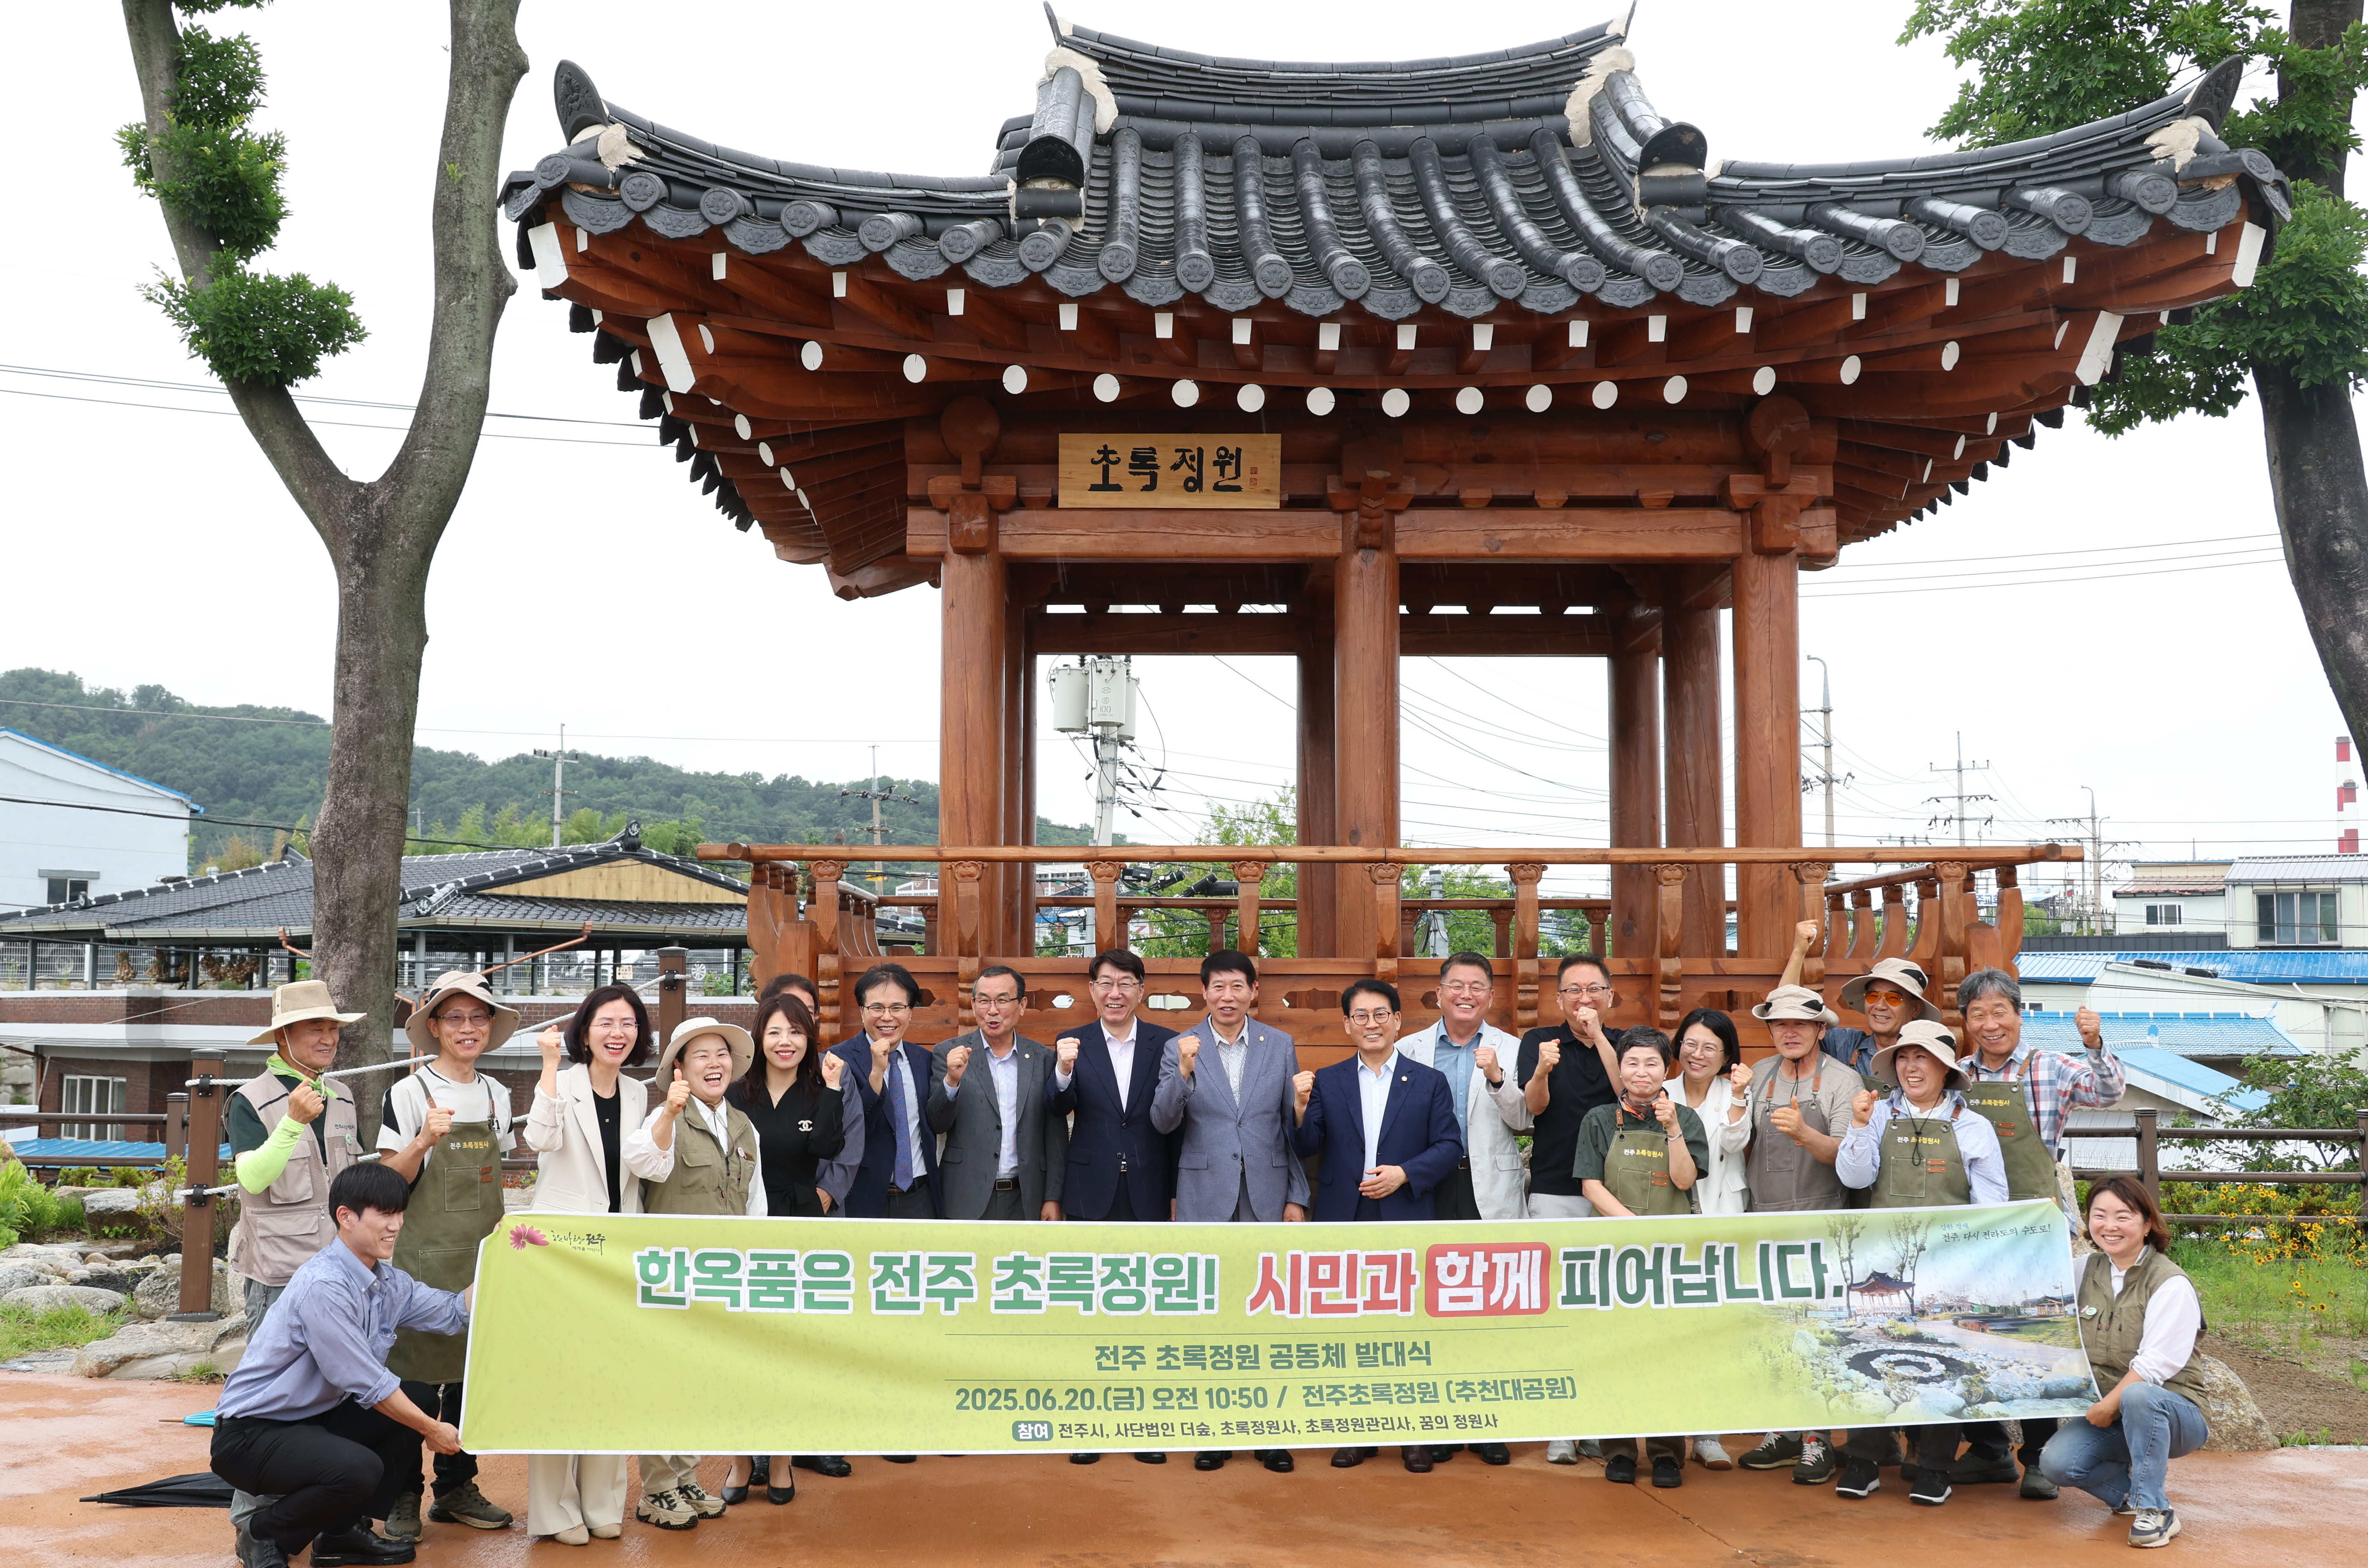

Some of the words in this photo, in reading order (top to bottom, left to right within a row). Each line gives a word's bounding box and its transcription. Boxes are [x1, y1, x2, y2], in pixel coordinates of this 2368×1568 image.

[1088, 444, 1243, 493] 초록정원
[462, 1141, 489, 1149] 초록정원사
[1942, 1233, 1960, 1242] 전주,
[1963, 1231, 1979, 1241] 다시
[1982, 1227, 2018, 1240] 전라도의
[2021, 1224, 2051, 1236] 수도로!
[636, 1250, 851, 1310] 한옥품은
[871, 1254, 975, 1311] 전주
[994, 1254, 1215, 1311] 초록정원!
[1249, 1252, 1417, 1314] 시민과
[1435, 1249, 1542, 1312] 함께
[1561, 1242, 1844, 1306] 피어납니다.
[1095, 1345, 1146, 1371] 전주
[1156, 1344, 1260, 1371] 초록정원
[1269, 1343, 1346, 1371] 공동체
[1355, 1340, 1432, 1368] 발대식
[956, 1386, 1145, 1412] 2025.06.20.(금)
[1152, 1387, 1199, 1411] 오전
[1205, 1386, 1269, 1409] 10:50
[1276, 1385, 1288, 1408] /
[1302, 1381, 1440, 1407] 전주초록정원
[1445, 1375, 1577, 1403] (추천대공원)
[1018, 1423, 1049, 1439] 참여
[1058, 1422, 1109, 1439] 전주시,
[1114, 1422, 1176, 1439] 사단법인
[1181, 1422, 1216, 1437] 더숲,
[1221, 1418, 1301, 1436] 초록정원사,
[1306, 1416, 1416, 1434] 초록정원관리사,
[1419, 1414, 1450, 1431] 꿈의
[1453, 1413, 1498, 1430] 정원사
